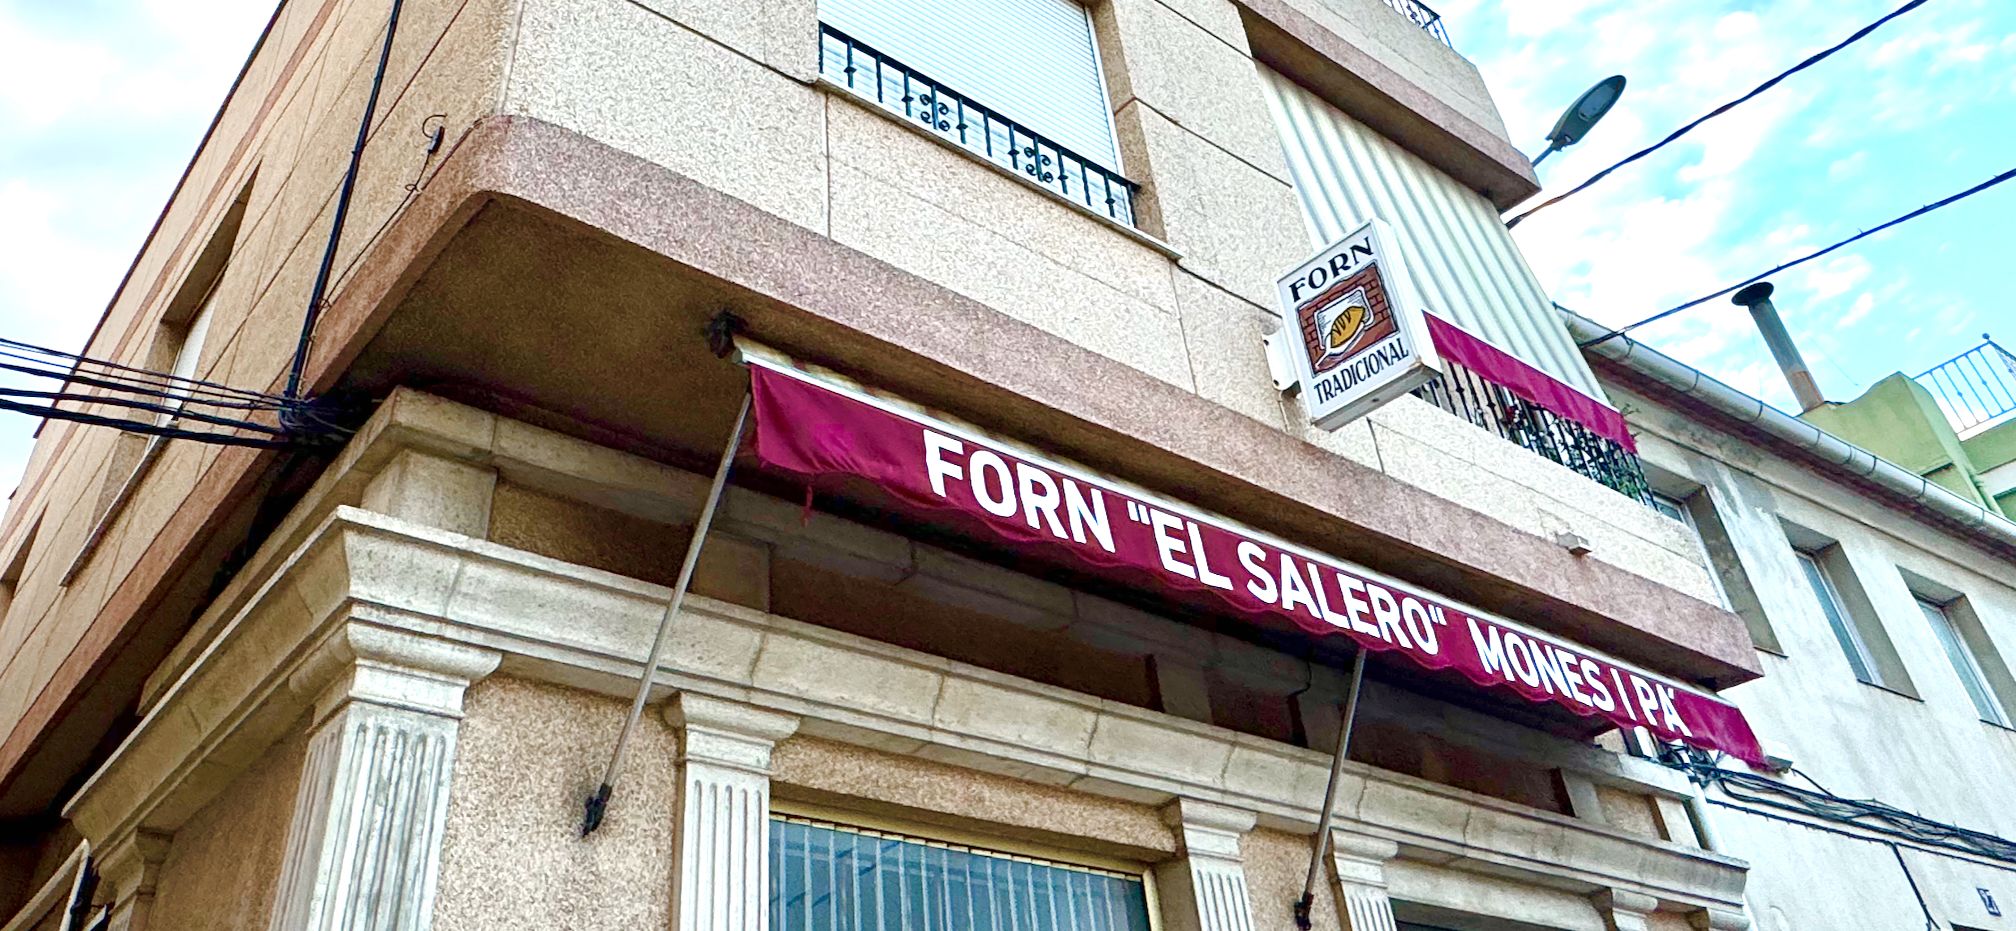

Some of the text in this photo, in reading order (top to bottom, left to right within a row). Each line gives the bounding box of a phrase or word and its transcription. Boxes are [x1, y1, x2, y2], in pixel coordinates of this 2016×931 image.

[1288, 236, 1375, 302] FORN
[1313, 338, 1409, 405] TRADICIONAL
[923, 429, 1116, 553] FORN
[1127, 500, 1233, 590] "EL
[1237, 541, 1448, 655] SALERO"
[1467, 617, 1615, 712] MONES
[1609, 667, 1637, 721] I
